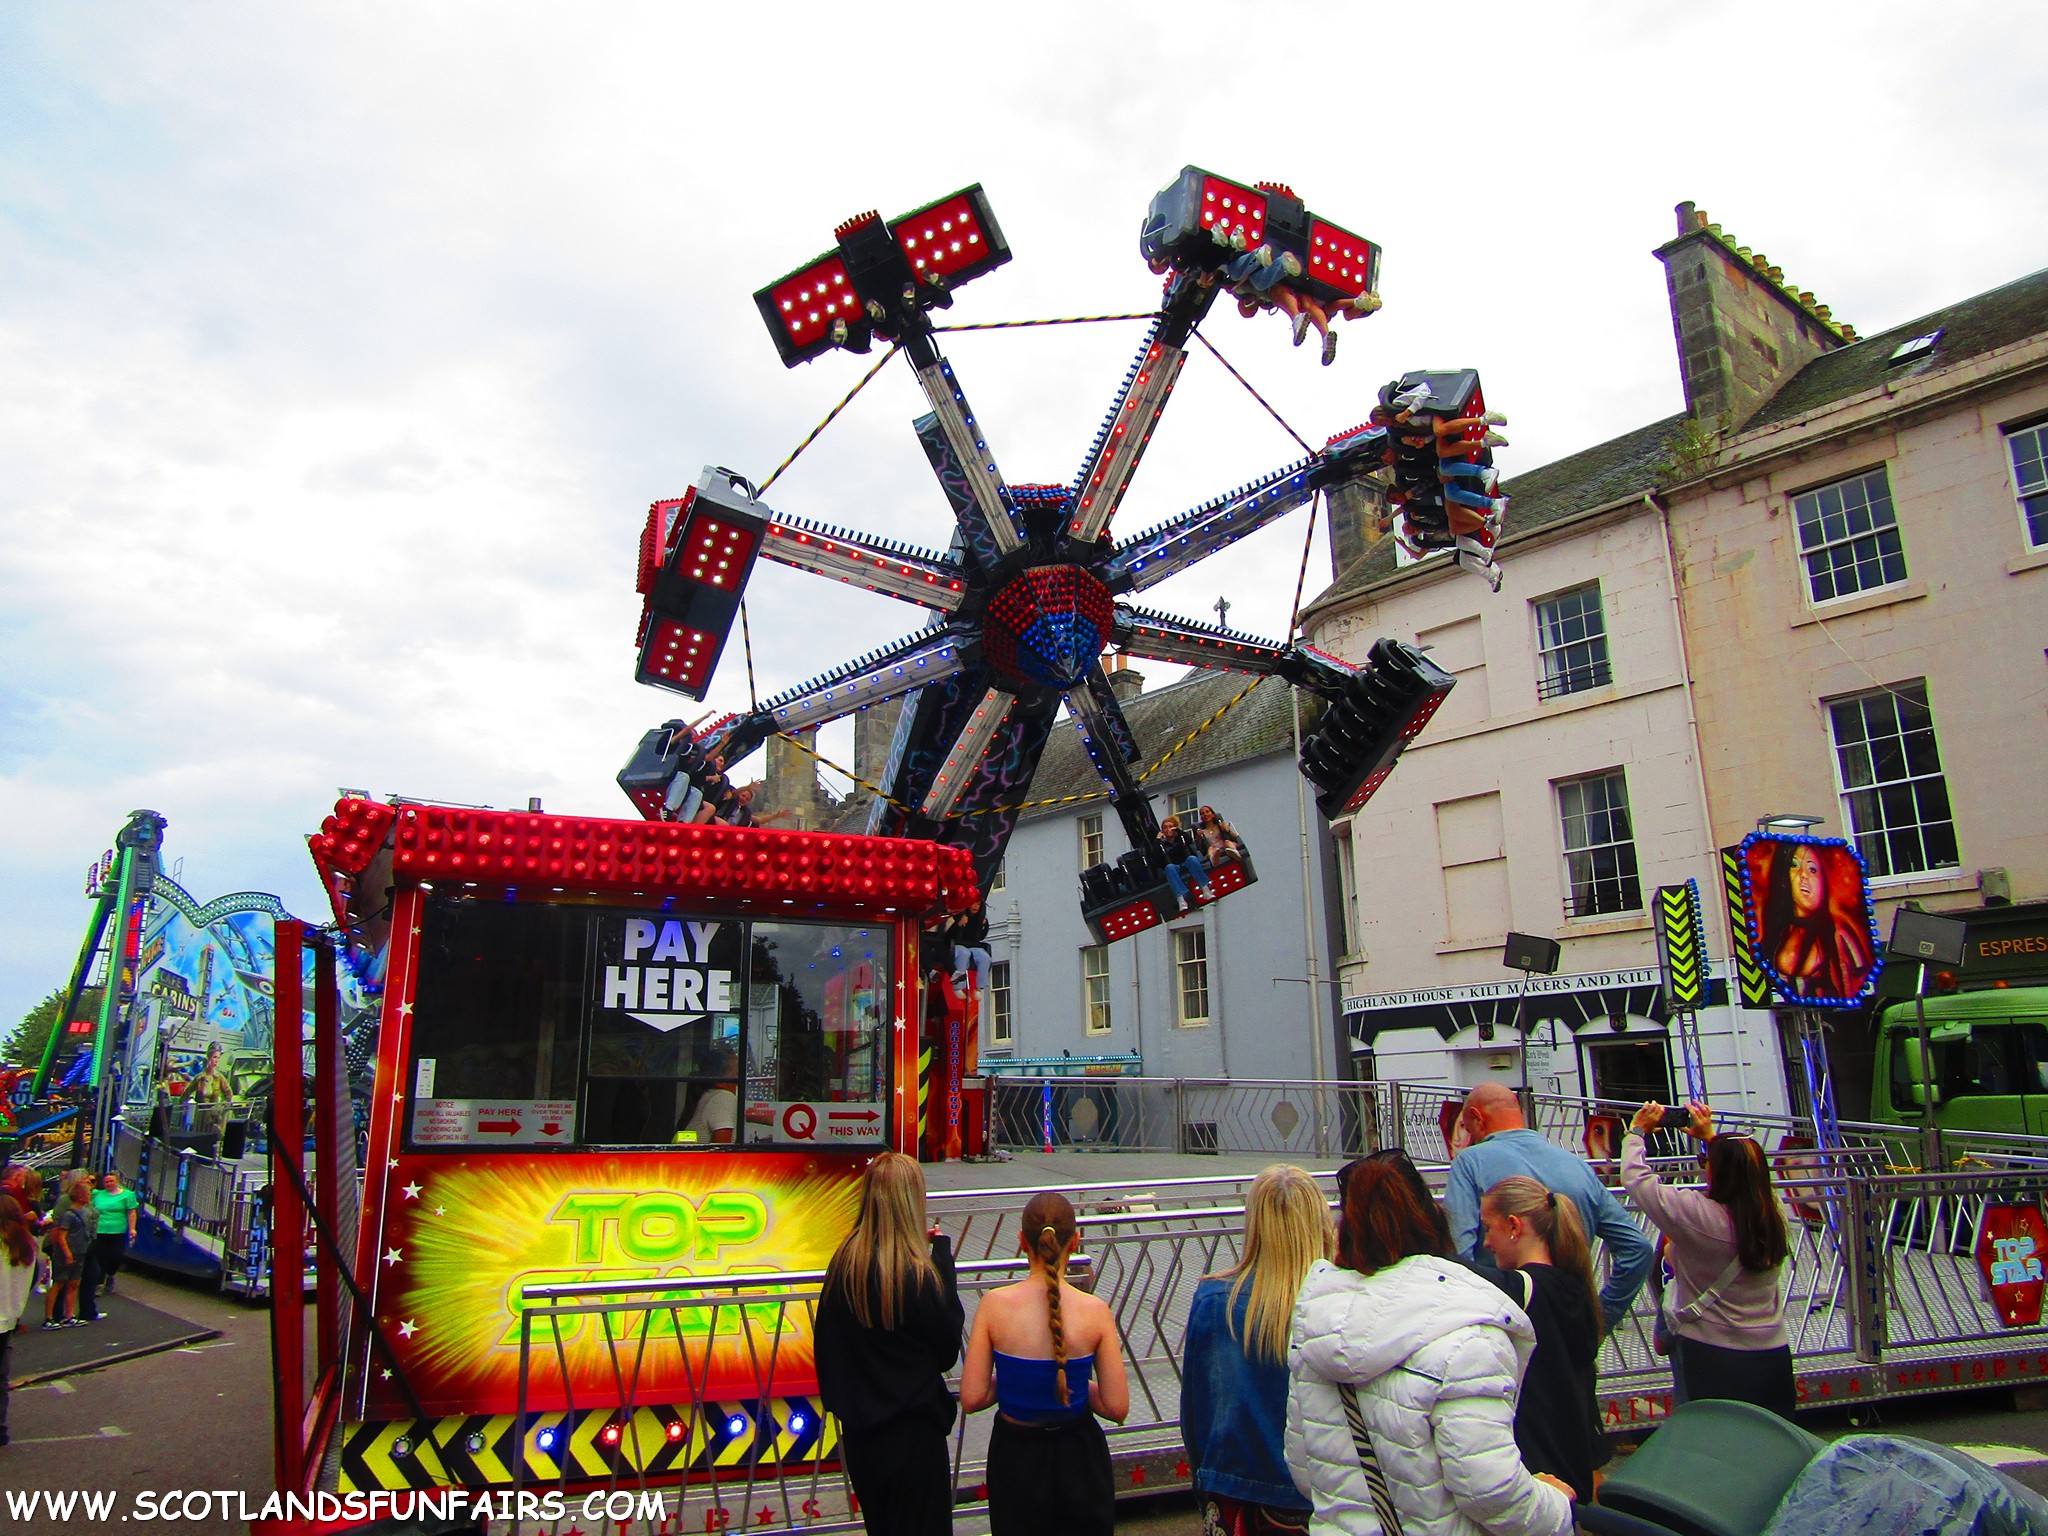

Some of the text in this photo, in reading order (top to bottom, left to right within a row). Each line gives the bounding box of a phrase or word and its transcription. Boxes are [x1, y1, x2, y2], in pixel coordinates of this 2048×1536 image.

[624, 918, 721, 963] PAY
[152, 983, 196, 1013] CABINS
[603, 965, 732, 1012] HERE
[1347, 970, 1654, 1011] HIGHLAND HOUSE KILT MAKERS AND KILT
[478, 1108, 523, 1117] PAY HERE
[782, 1103, 817, 1140] Q
[828, 1126, 881, 1137] THIS WAY
[551, 1191, 768, 1263] TOP
[1993, 1236, 2035, 1261] TOP
[1990, 1257, 2044, 1286] STAR
[497, 1264, 797, 1345] STAR
